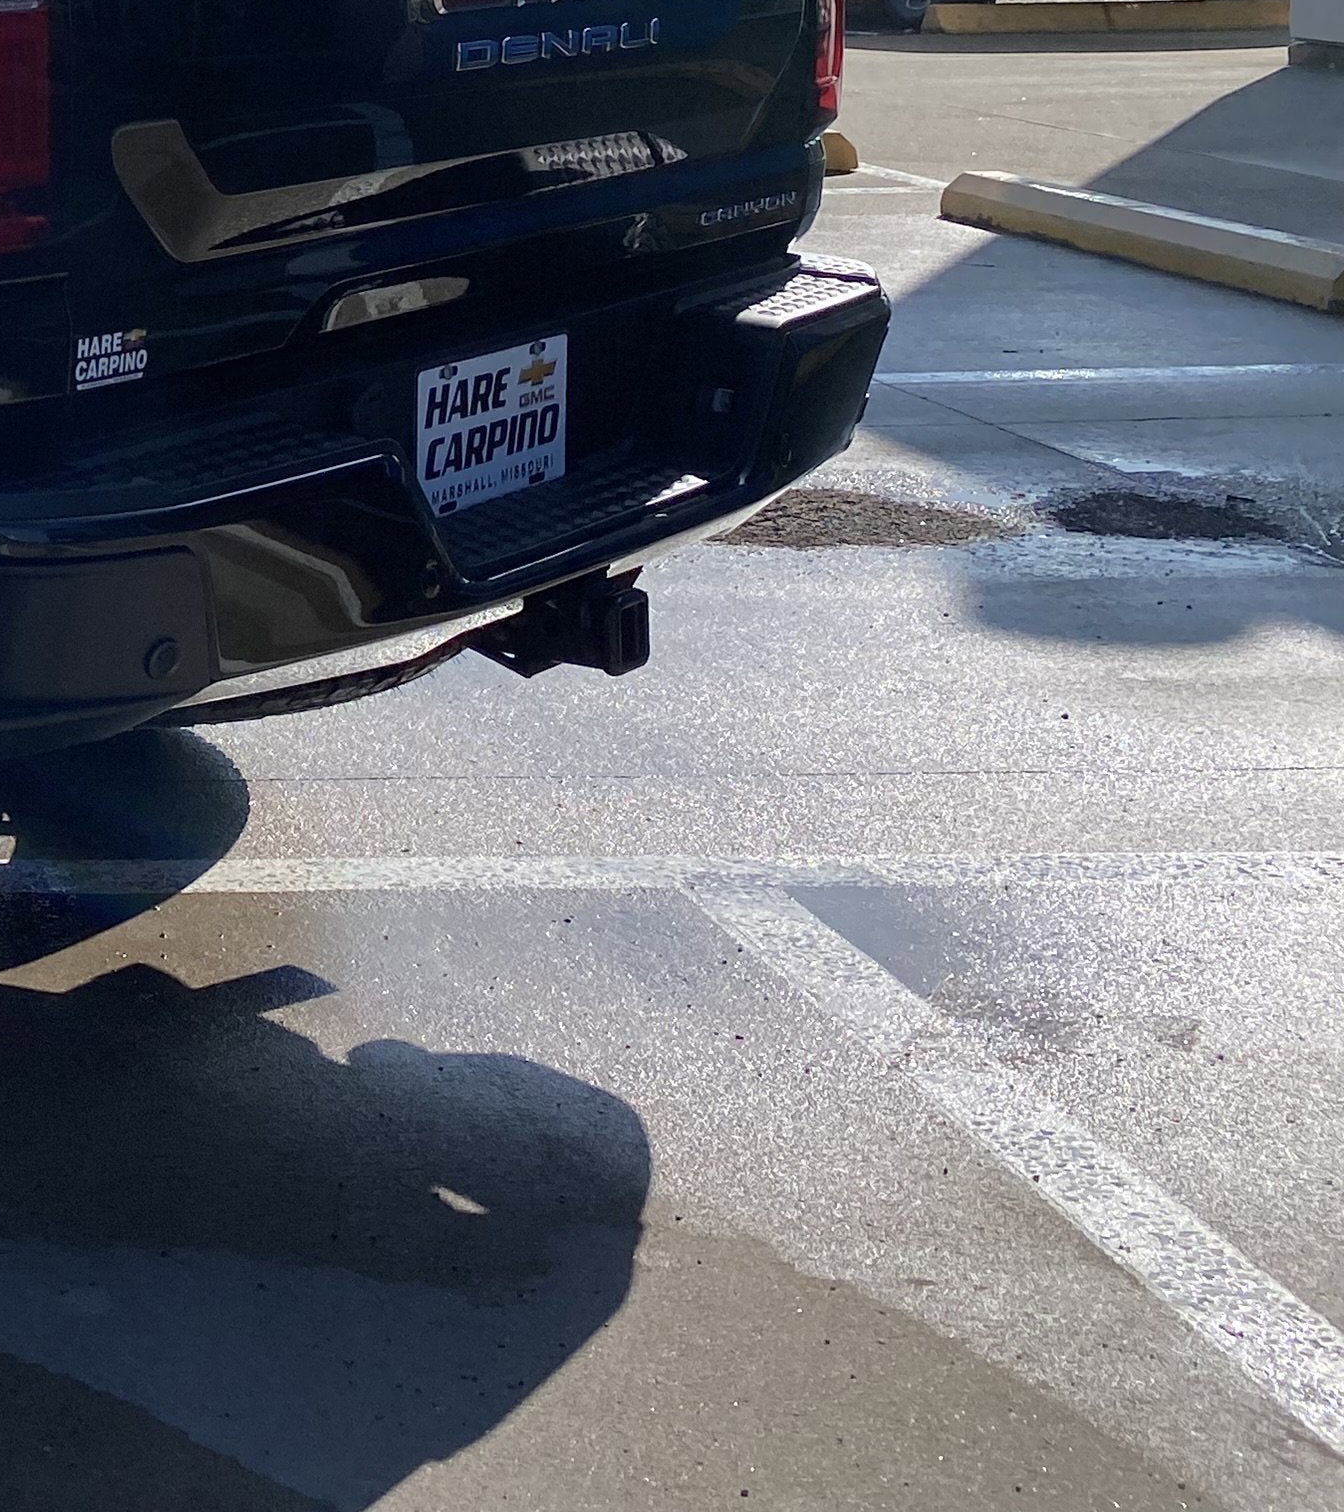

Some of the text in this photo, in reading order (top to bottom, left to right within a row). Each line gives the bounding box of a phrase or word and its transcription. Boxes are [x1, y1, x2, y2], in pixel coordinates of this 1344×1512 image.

[455, 17, 660, 71] DENALI
[75, 349, 148, 381] CARPINO
[77, 331, 123, 359] HARE
[424, 367, 511, 429] HARE
[519, 385, 555, 408] GMC
[424, 403, 560, 481] CARPINO
[431, 453, 554, 505] MARSHALL, MISSOURI
